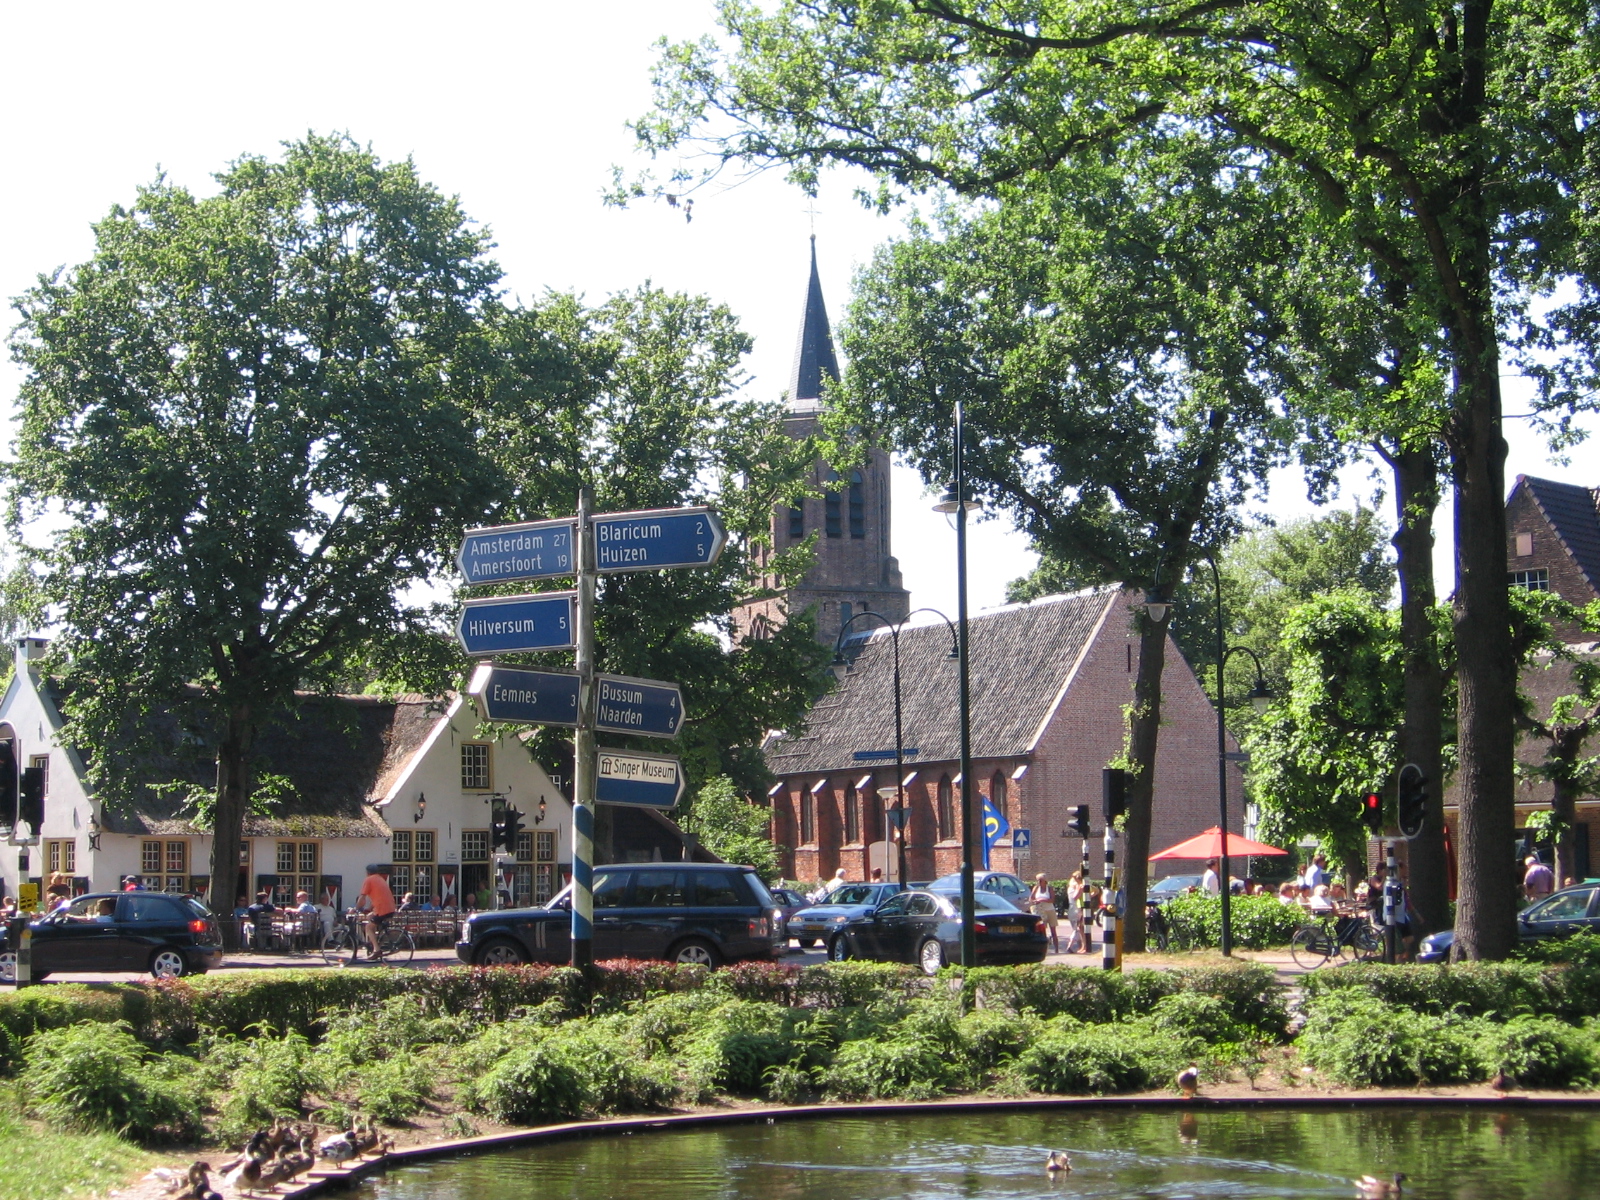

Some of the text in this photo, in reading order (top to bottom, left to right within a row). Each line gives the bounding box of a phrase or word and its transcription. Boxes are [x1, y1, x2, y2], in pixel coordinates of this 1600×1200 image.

[600, 522, 703, 542] Blaricum 2
[471, 533, 566, 556] Amsterdam 27
[600, 543, 704, 563] Huizen 5
[472, 554, 568, 577] Amersfoort 19
[469, 617, 566, 637] Hilversum 5
[493, 684, 576, 707] Eemnes 3
[602, 683, 676, 709] Bussum 4
[600, 704, 674, 729] Naarden 6
[613, 758, 675, 780] Singer Museum
